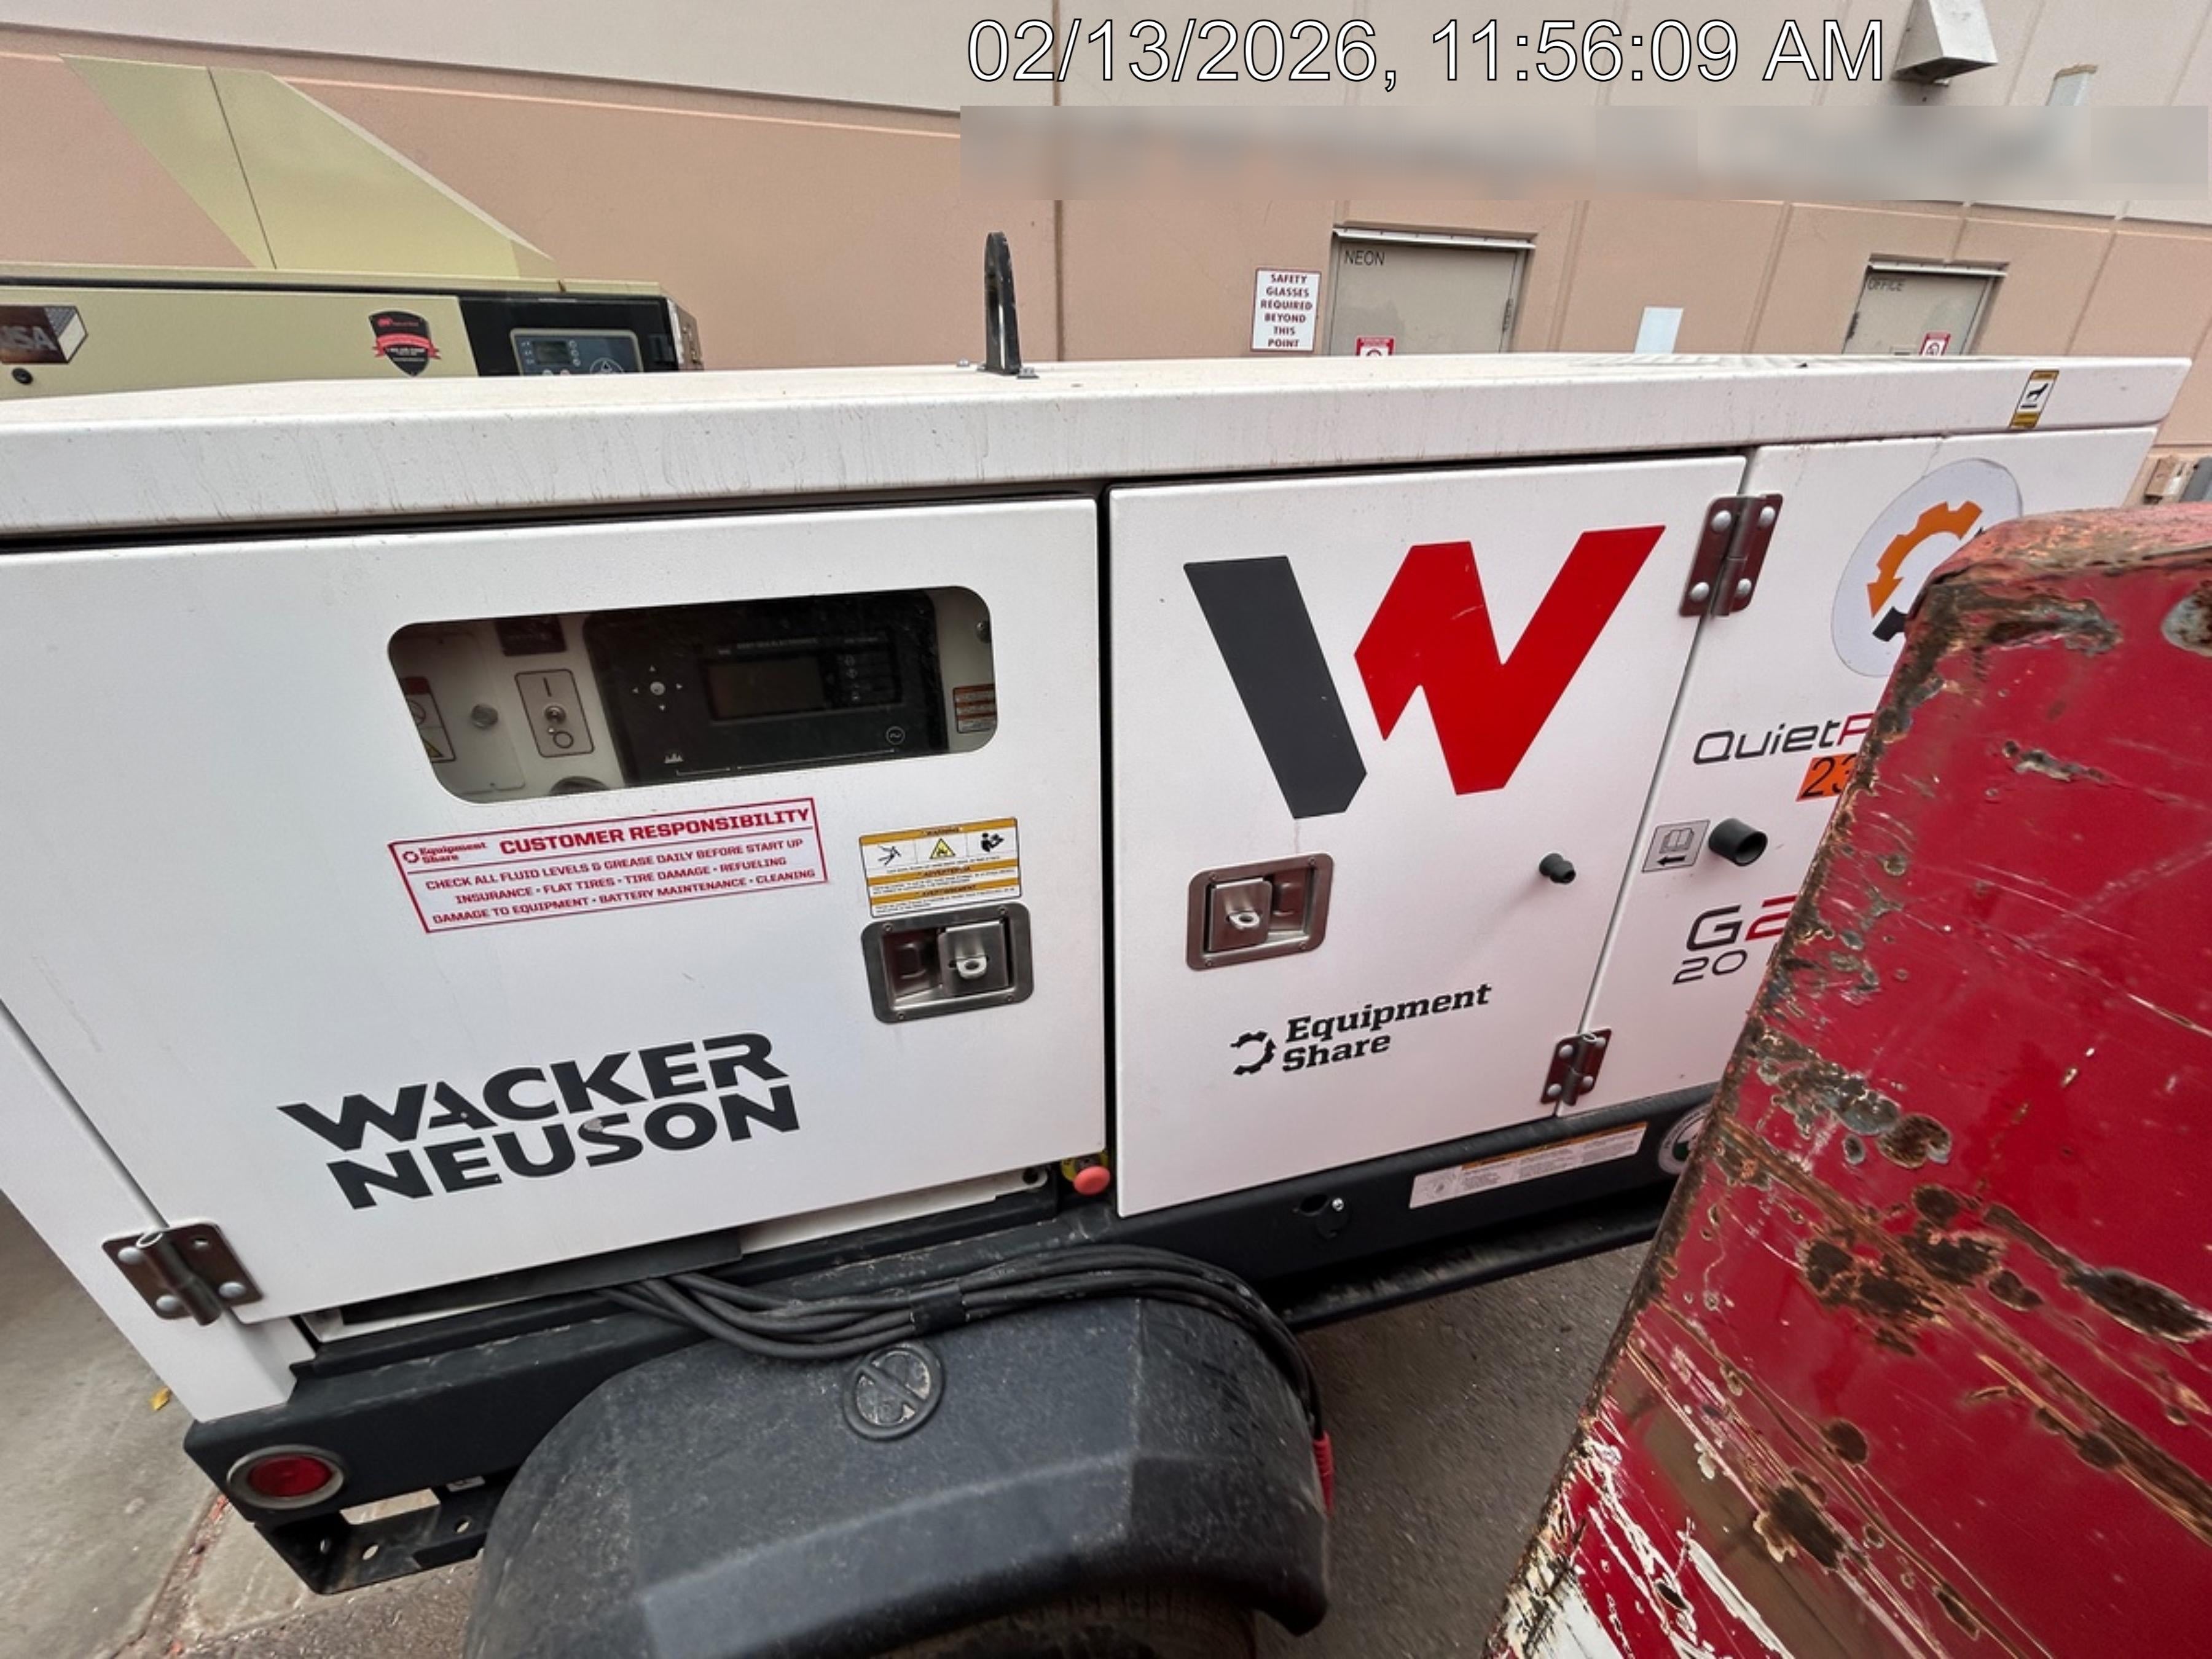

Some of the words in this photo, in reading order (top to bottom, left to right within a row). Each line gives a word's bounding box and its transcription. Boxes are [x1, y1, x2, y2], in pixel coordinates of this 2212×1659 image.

[1344, 250, 1385, 266] NEON
[1266, 285, 1309, 297] GLASSES
[1271, 274, 1308, 284] SAFETY
[1260, 299, 1313, 310] REQUIRED
[1264, 313, 1306, 323] BEYOND
[1273, 326, 1295, 335] THIS
[418, 842, 487, 855] Equipment
[499, 828, 626, 855] CUSTOMER
[629, 808, 810, 841] RESPONSIBILITY
[422, 854, 460, 864] Share
[425, 879, 473, 890] CHECK
[474, 874, 498, 885] ALL
[500, 870, 539, 882] FLUID
[541, 863, 589, 876] LEVELS
[604, 855, 654, 870] GREASE
[657, 851, 694, 863] DAILY
[696, 845, 744, 859] BEFORE
[746, 840, 784, 853] START
[787, 838, 804, 848] UP
[432, 909, 490, 924] DAMAGE
[492, 906, 510, 916] TO
[512, 896, 590, 914] EQUIPMENT
[600, 888, 654, 904] BATTERY
[657, 877, 747, 897] MAINTENANCE
[755, 868, 816, 884] CLEANING
[455, 886, 533, 904] INSURANCE
[543, 882, 573, 894] FLAT
[575, 877, 615, 890] TIRES
[624, 873, 654, 884] TIRE
[657, 866, 711, 880] DAMAGE
[720, 857, 787, 873] REFUELING
[1672, 949, 1747, 984] 20
[1285, 983, 1492, 1045] Equipment
[1282, 1034, 1391, 1072] Share
[276, 1032, 789, 1151] WACKER
[326, 1084, 801, 1210] NEUSON
